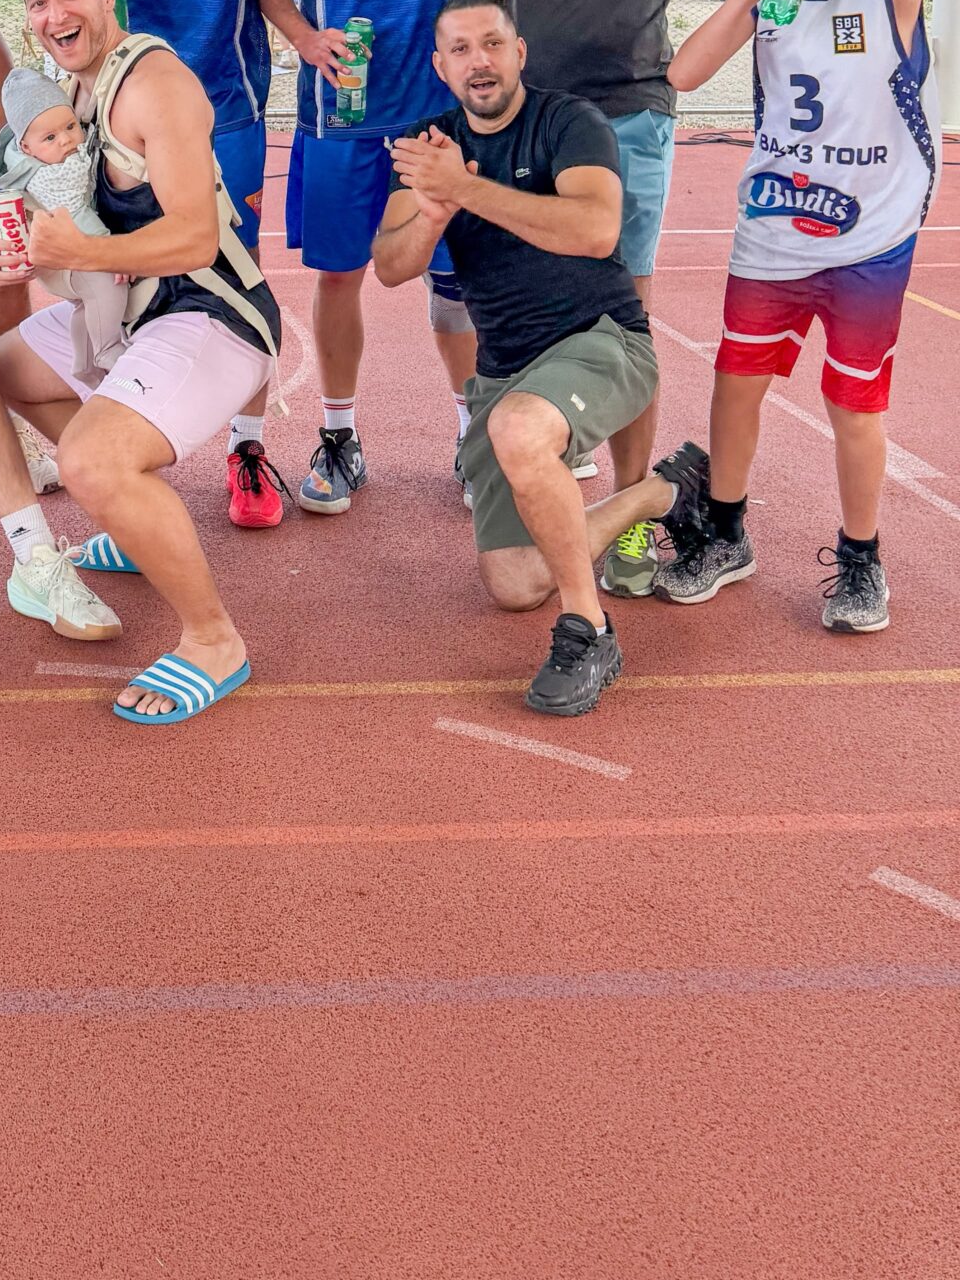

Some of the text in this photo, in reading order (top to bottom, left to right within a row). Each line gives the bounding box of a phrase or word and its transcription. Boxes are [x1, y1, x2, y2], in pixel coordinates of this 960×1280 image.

[835, 16, 861, 29] SBA
[790, 74, 824, 133] 3
[822, 145, 888, 166] TOUR
[748, 179, 852, 221] Budiš
